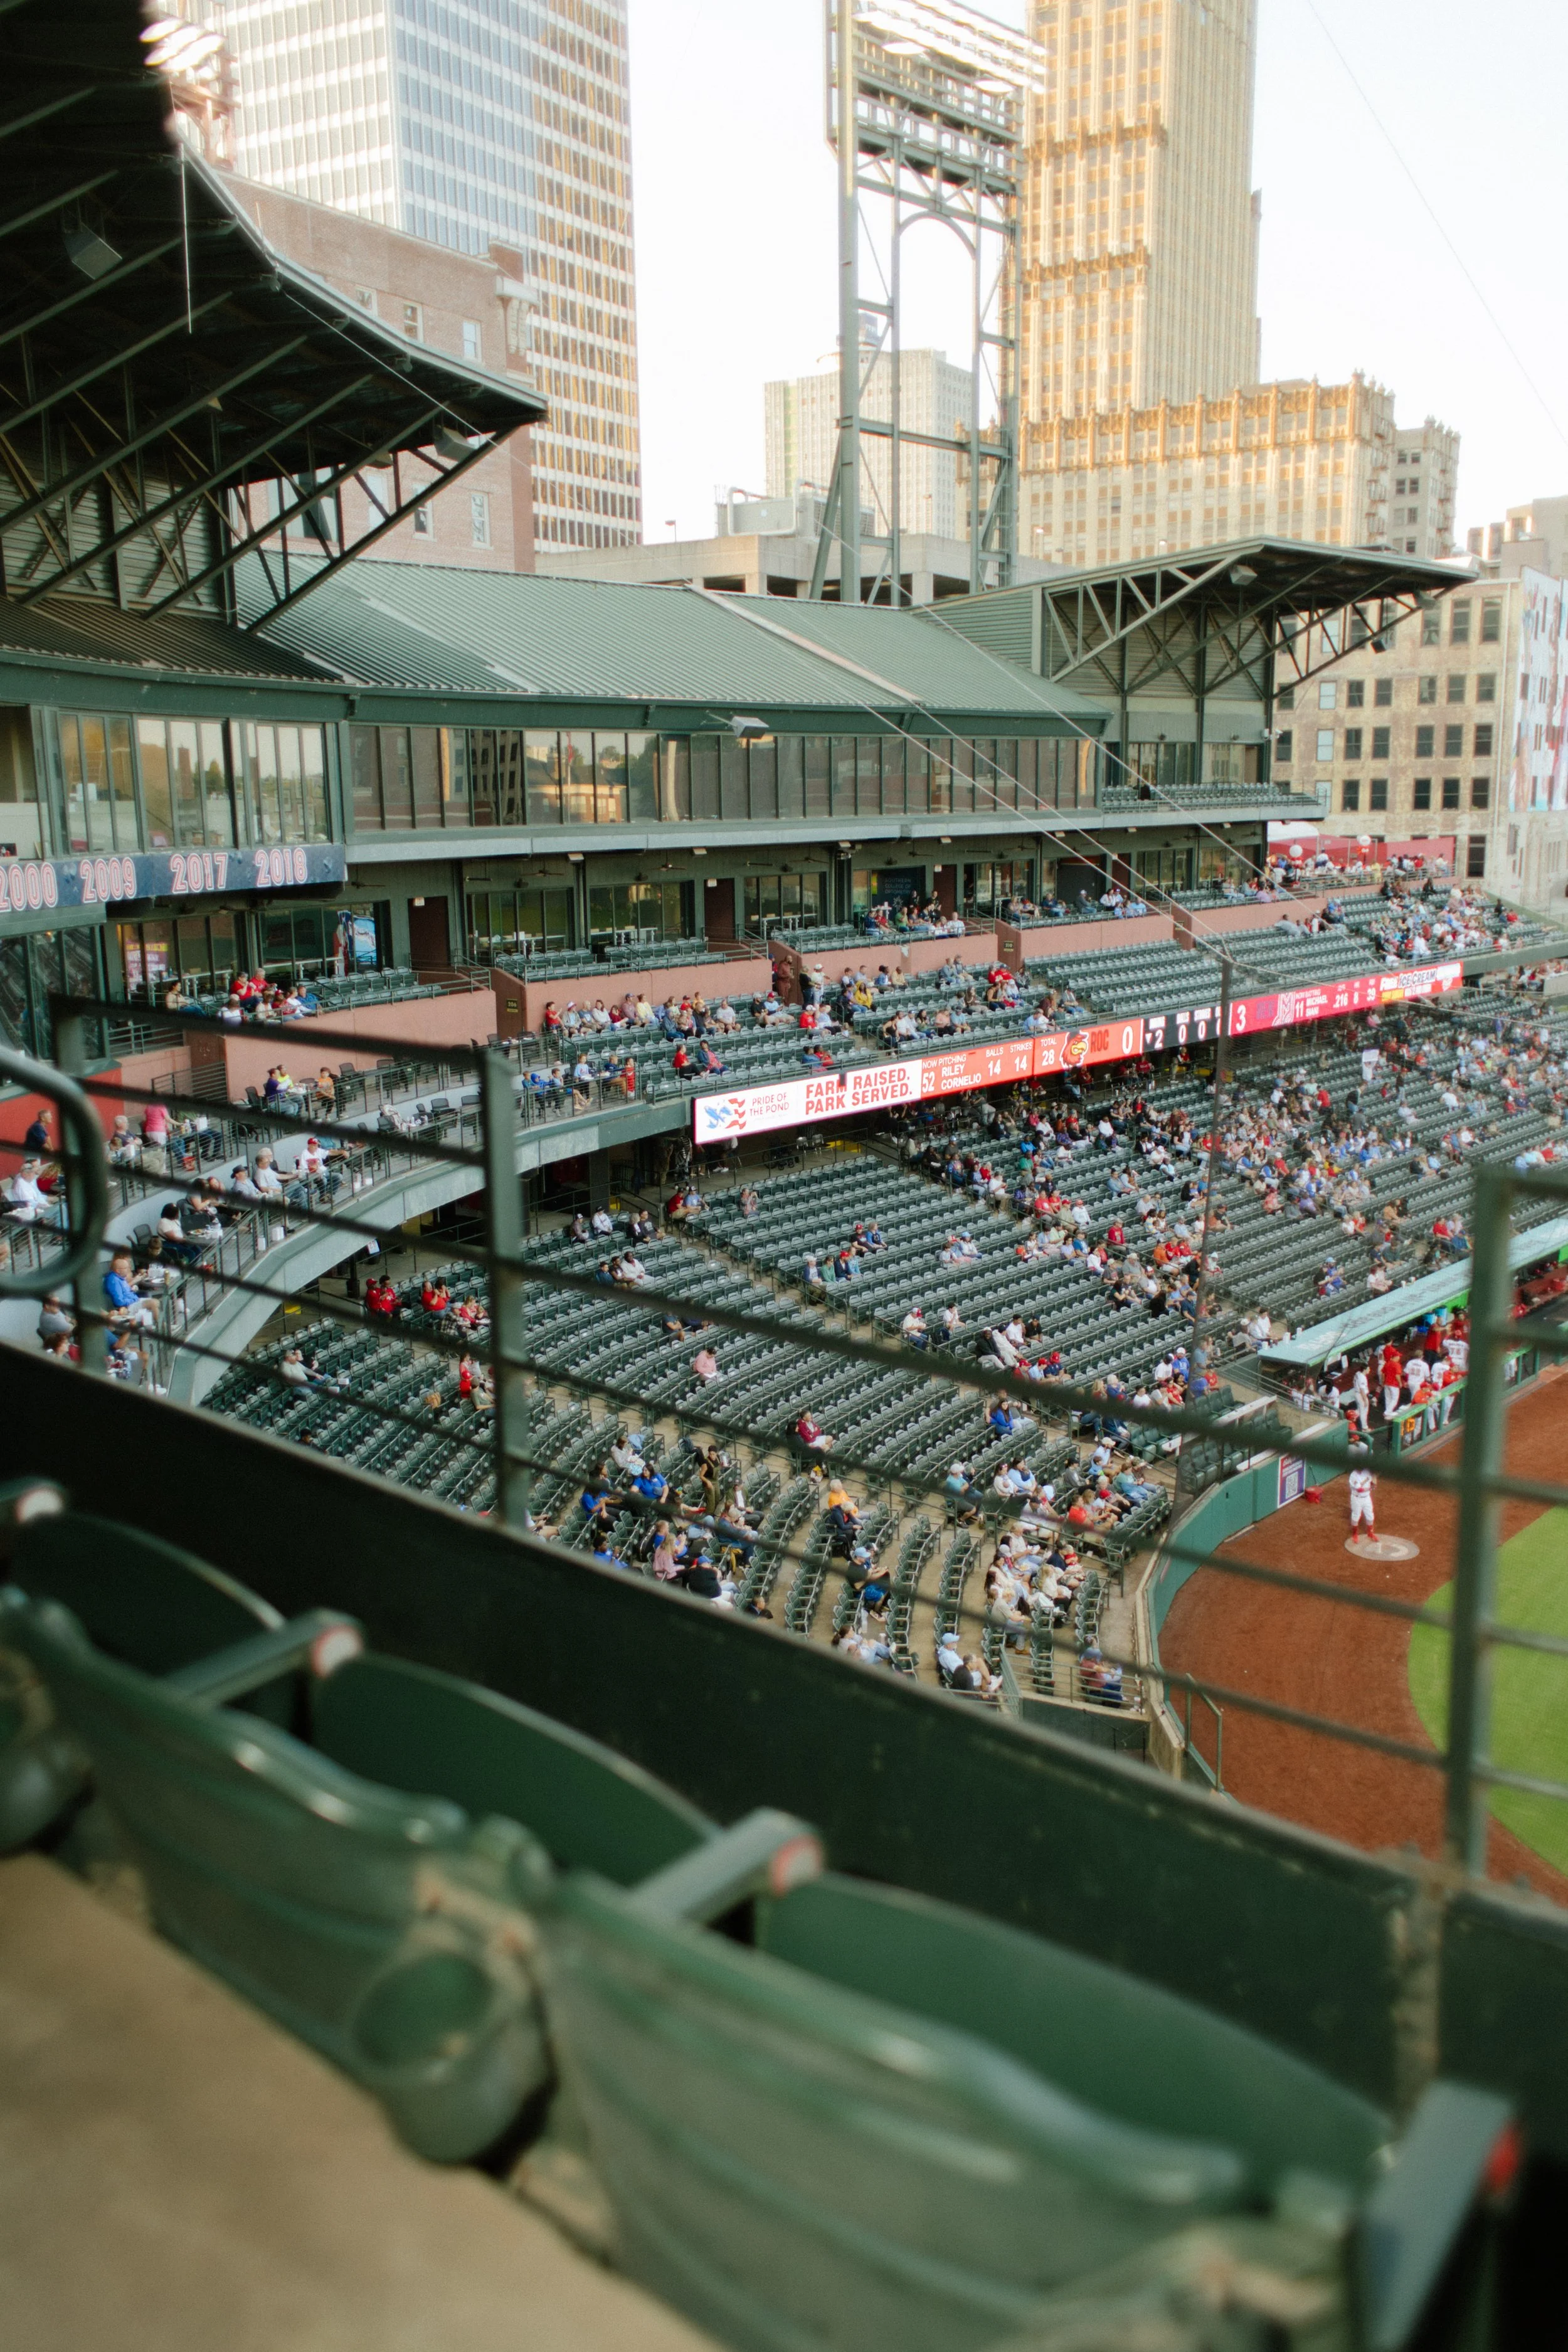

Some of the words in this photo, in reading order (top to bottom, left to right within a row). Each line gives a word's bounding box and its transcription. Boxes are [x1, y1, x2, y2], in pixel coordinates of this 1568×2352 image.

[171, 852, 228, 894] 2017
[255, 847, 308, 887] 2018
[80, 857, 137, 903] 2009
[1399, 975, 1411, 987] ICE
[1412, 970, 1436, 985] CREAM
[1306, 995, 1328, 1007] MICHAEL
[1333, 992, 1348, 1009] .216
[1353, 991, 1359, 1004] 8
[1367, 988, 1376, 1002] 39
[1236, 1005, 1246, 1031] 3
[1295, 1000, 1304, 1018] 11
[1121, 1025, 1133, 1054] 0
[1154, 1029, 1163, 1050] 2
[1179, 1024, 1187, 1045] 0
[1198, 1020, 1207, 1041] 0
[1010, 1042, 1032, 1054] STRIKES
[1041, 1037, 1057, 1047] TOTAL
[1091, 1029, 1109, 1053] ROC
[922, 1057, 938, 1069] NOW
[939, 1054, 967, 1066] PITCHING
[986, 1047, 1004, 1058] BALLS
[1042, 1049, 1055, 1066] 28
[941, 1063, 966, 1076] RILEY
[988, 1059, 1001, 1077] 14
[1014, 1055, 1027, 1072] 14
[853, 1067, 910, 1091] RAISED.
[922, 1071, 935, 1093] 52
[941, 1073, 982, 1091] CORNELIO
[752, 1094, 775, 1106] PRIDE
[777, 1092, 787, 1102] OF
[805, 1094, 846, 1115] PARK
[851, 1083, 913, 1106] SERVED.
[750, 1106, 763, 1116] THE
[766, 1102, 789, 1114] POND
